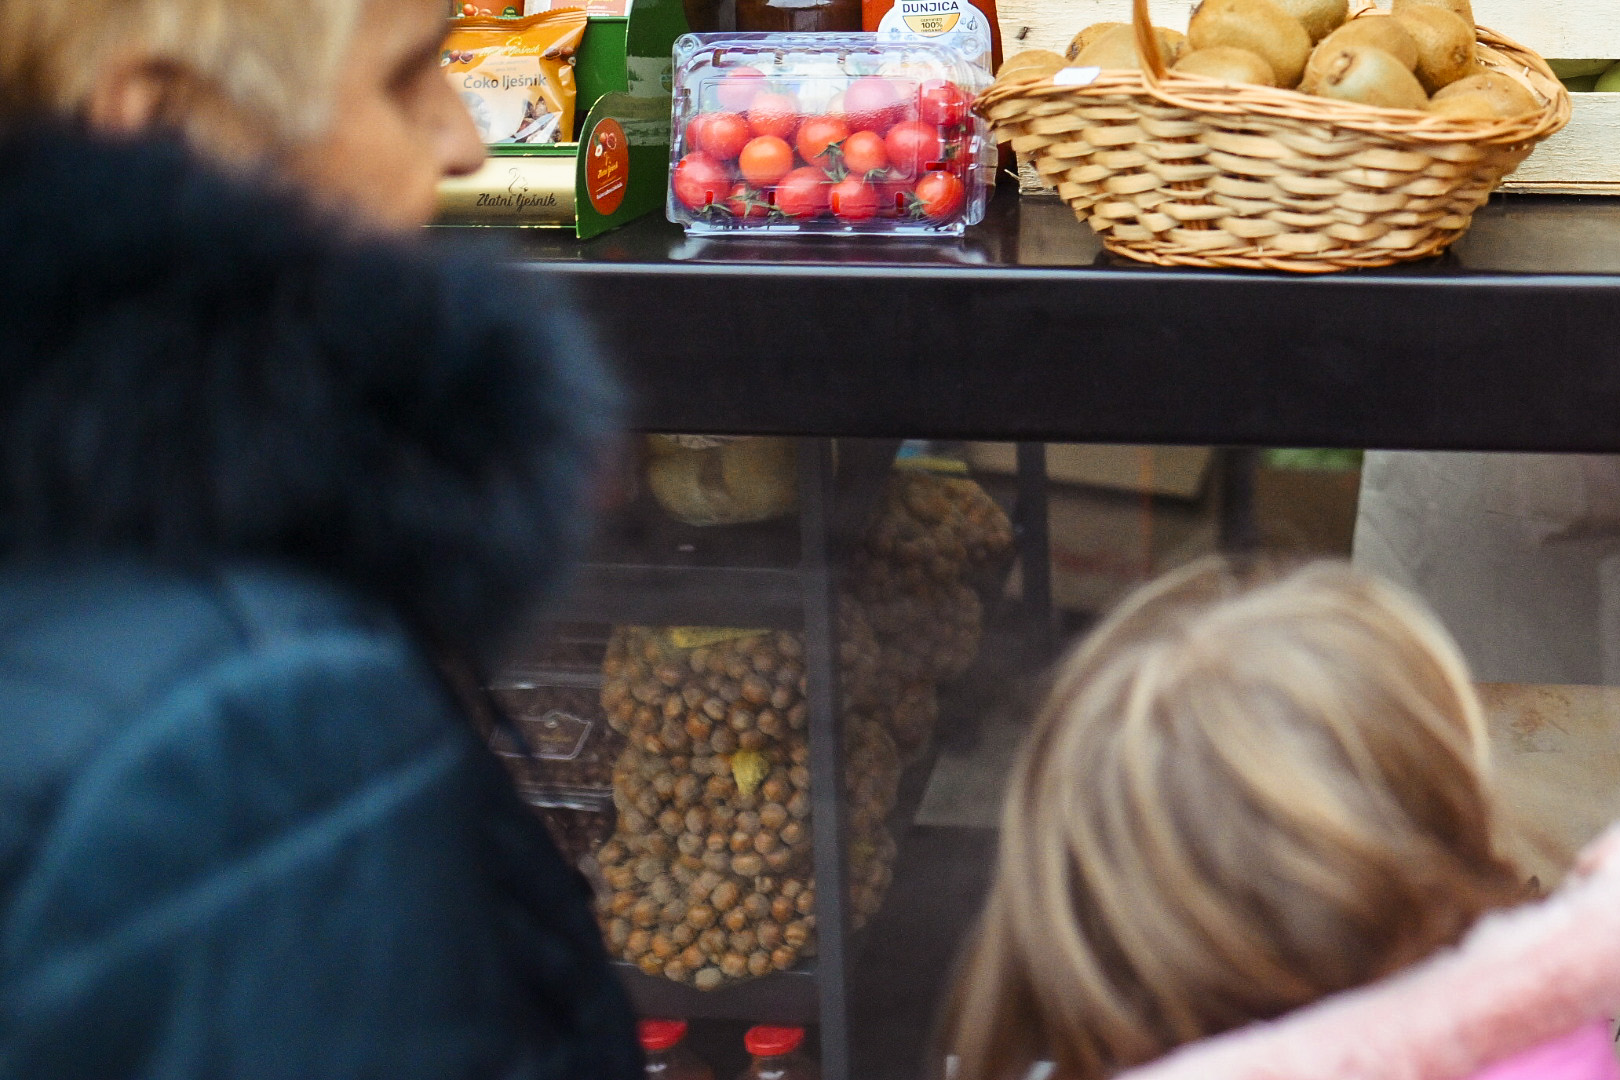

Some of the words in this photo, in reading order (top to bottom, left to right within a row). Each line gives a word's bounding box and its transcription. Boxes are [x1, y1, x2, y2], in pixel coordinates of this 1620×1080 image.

[902, 1, 959, 13] DUNJICA
[463, 74, 499, 89] Čoko
[502, 73, 547, 90] lješnik
[476, 193, 514, 207] Zlatni
[515, 192, 557, 212] lješnik
